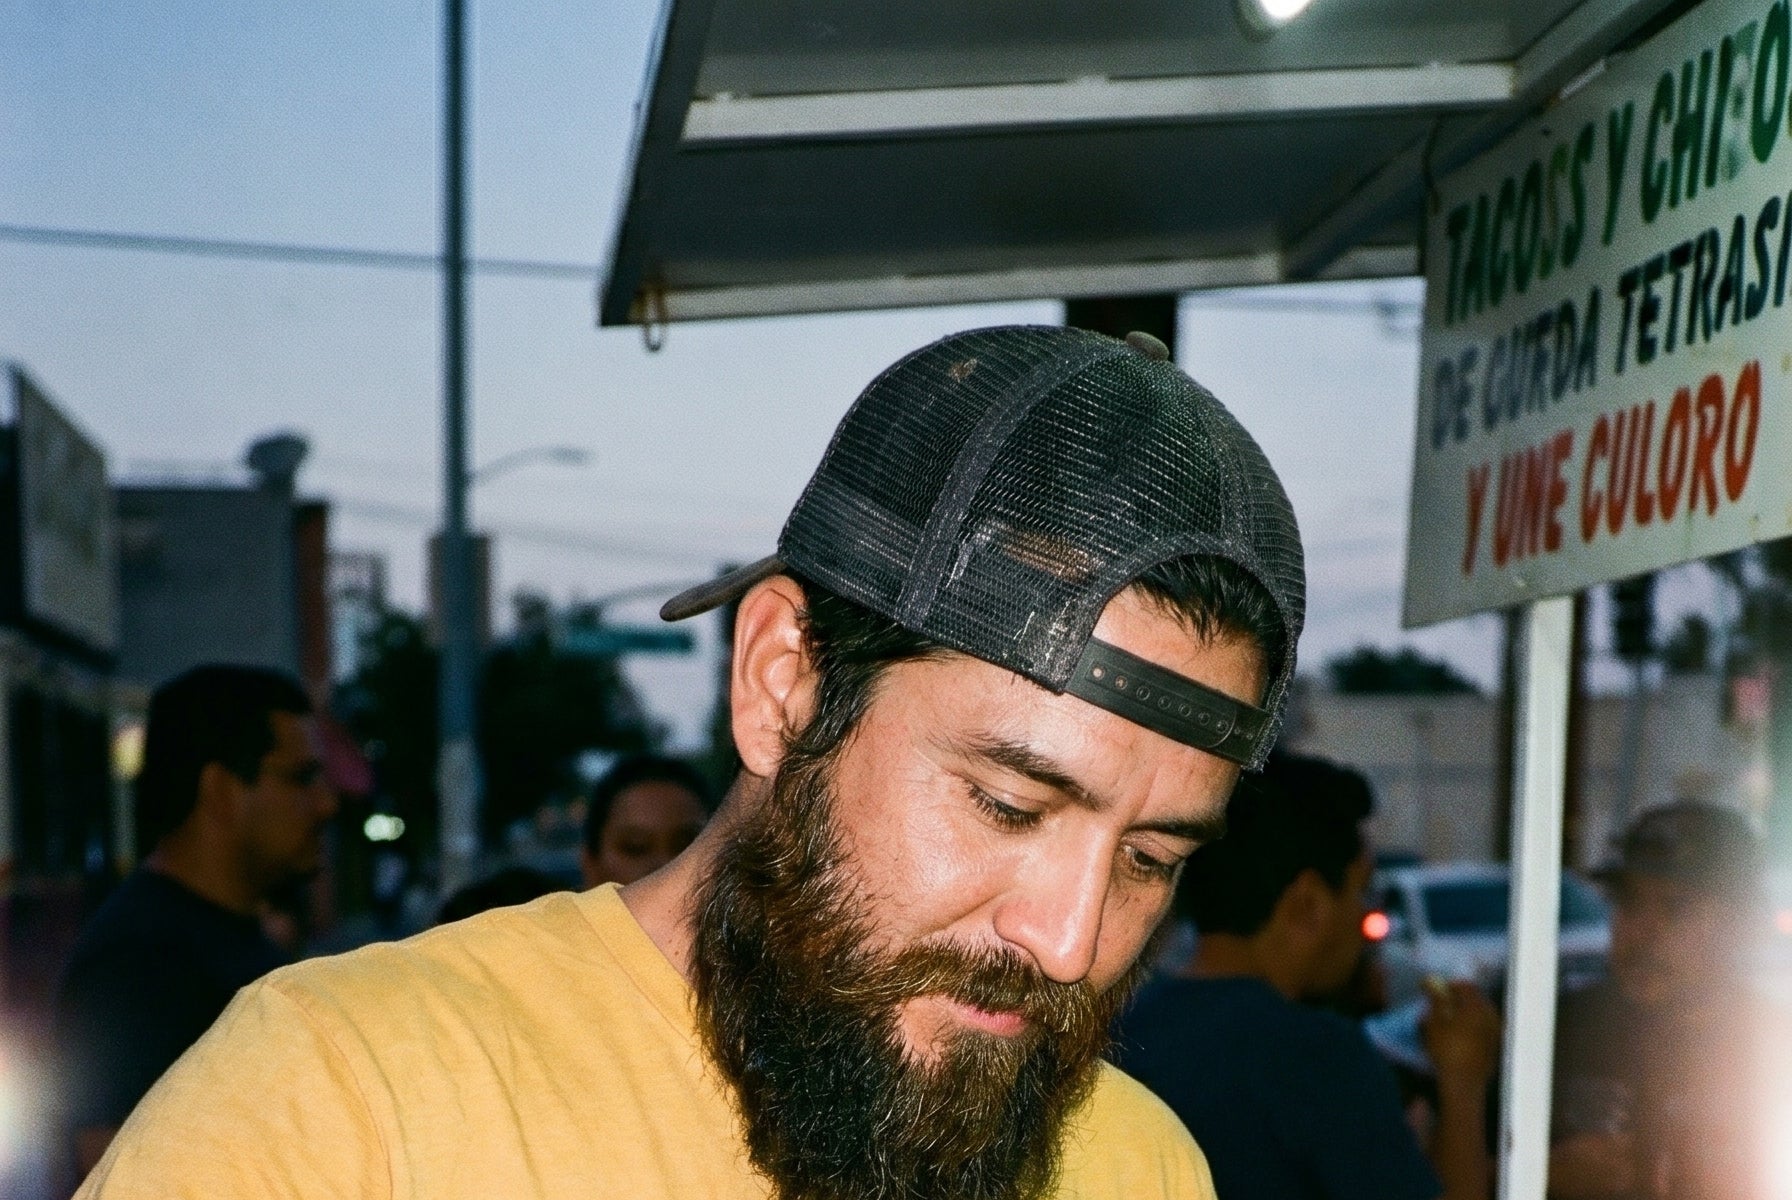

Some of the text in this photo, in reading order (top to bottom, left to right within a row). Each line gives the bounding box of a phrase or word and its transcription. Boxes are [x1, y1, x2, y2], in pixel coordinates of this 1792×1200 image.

[1600, 102, 1635, 247] Y
[1461, 460, 1491, 576] Y
[1580, 360, 1762, 545] CULORO
